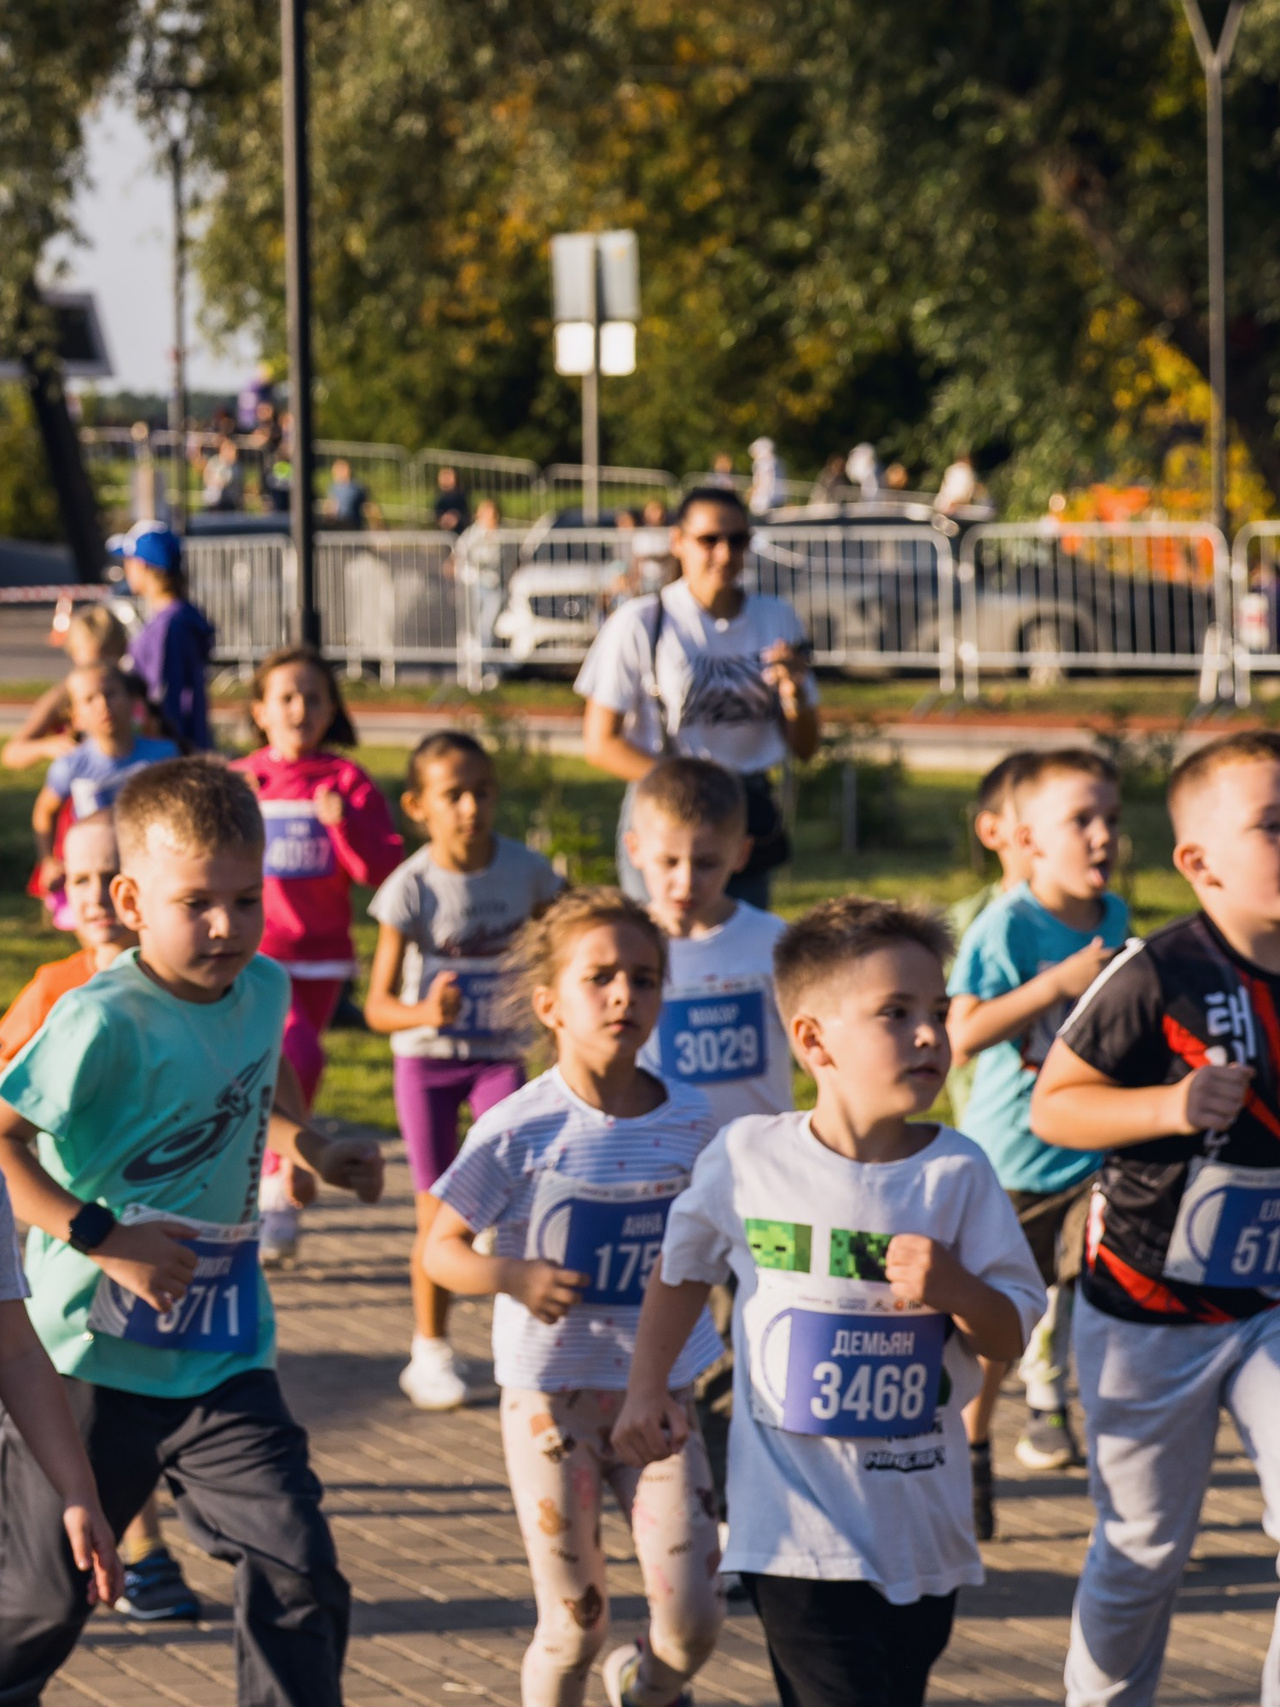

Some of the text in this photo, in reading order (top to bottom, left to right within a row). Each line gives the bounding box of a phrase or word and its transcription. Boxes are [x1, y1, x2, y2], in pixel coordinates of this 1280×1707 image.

[674, 1024, 759, 1075] 3029
[595, 1240, 662, 1292] 175
[1231, 1225, 1280, 1275] 51
[831, 1329, 915, 1358] ДЕМЬЯН
[810, 1361, 928, 1421] 3468
